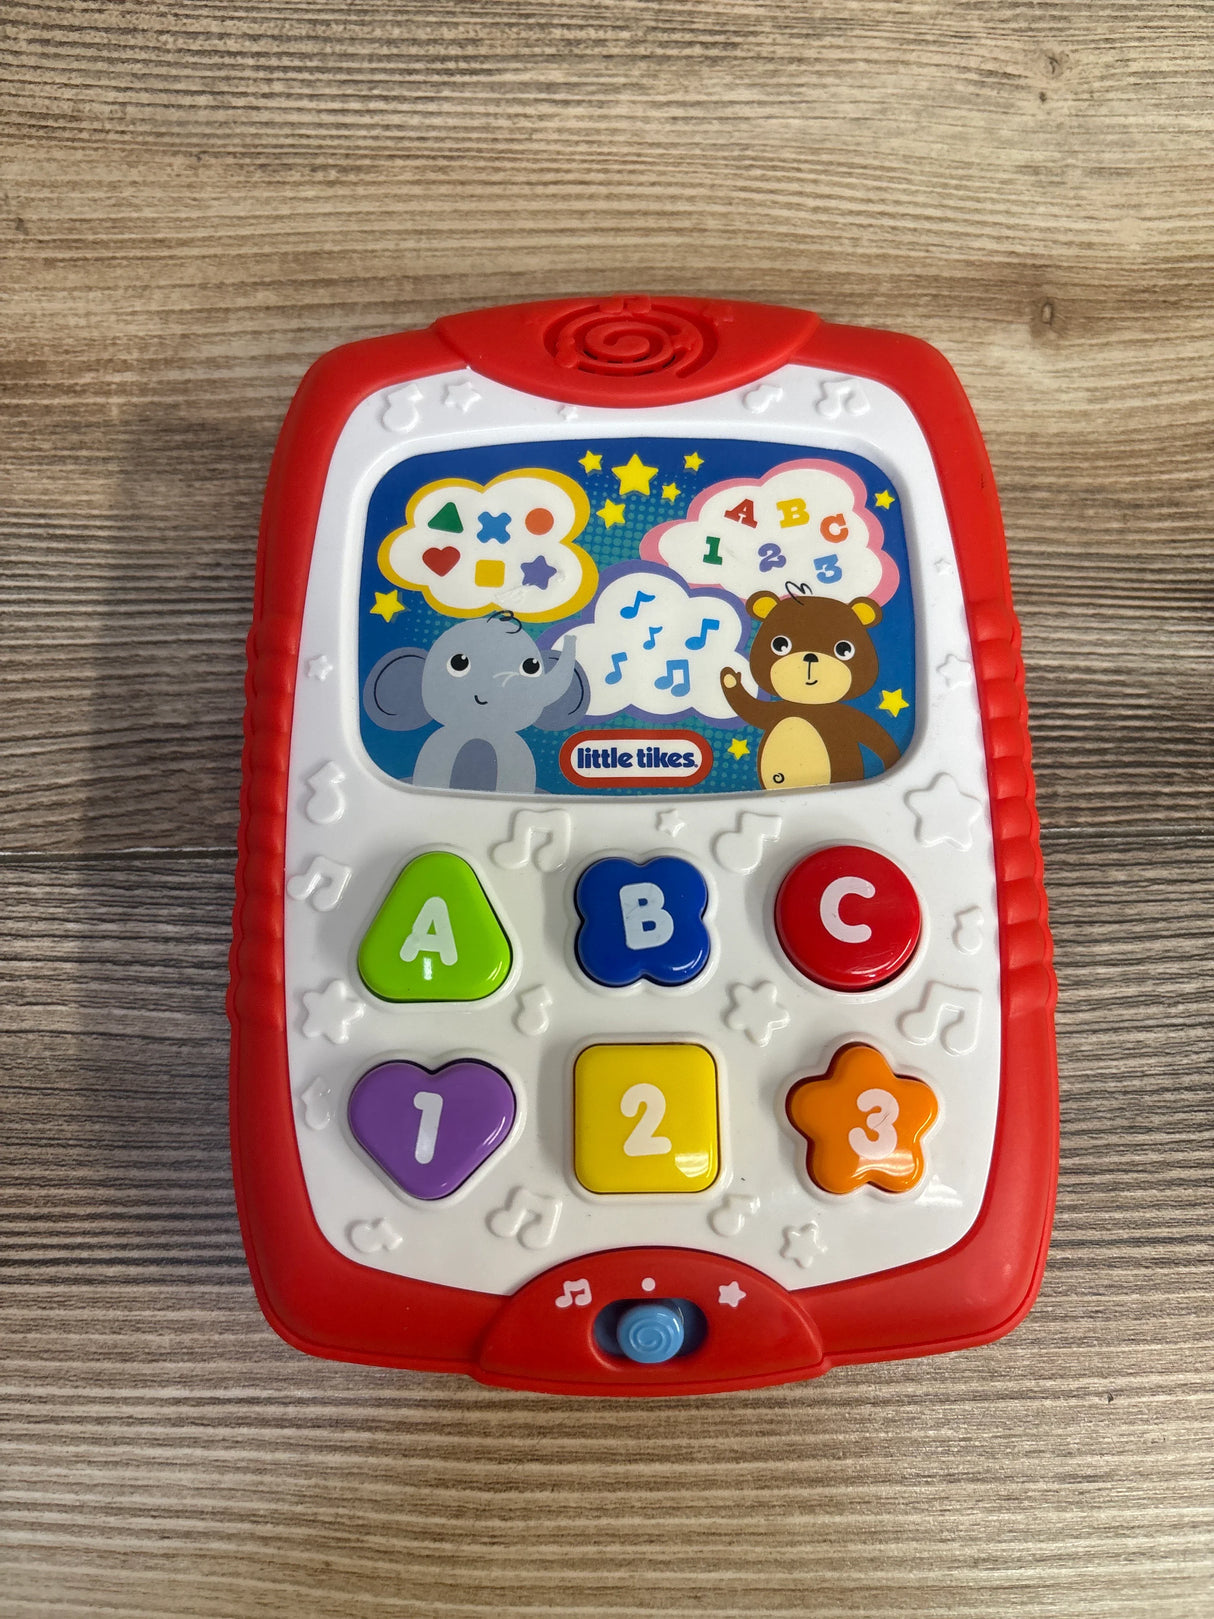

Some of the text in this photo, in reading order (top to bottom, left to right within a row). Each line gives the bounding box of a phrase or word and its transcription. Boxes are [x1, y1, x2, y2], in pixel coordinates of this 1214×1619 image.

[724, 498, 849, 543] A B C
[703, 536, 842, 584] 1 2 3
[577, 747, 695, 768] little tikes
[399, 896, 458, 966] A
[619, 882, 674, 950] B
[820, 876, 876, 944] C
[413, 1090, 443, 1164] 1
[620, 1082, 672, 1157] 2
[848, 1087, 899, 1161] 3
